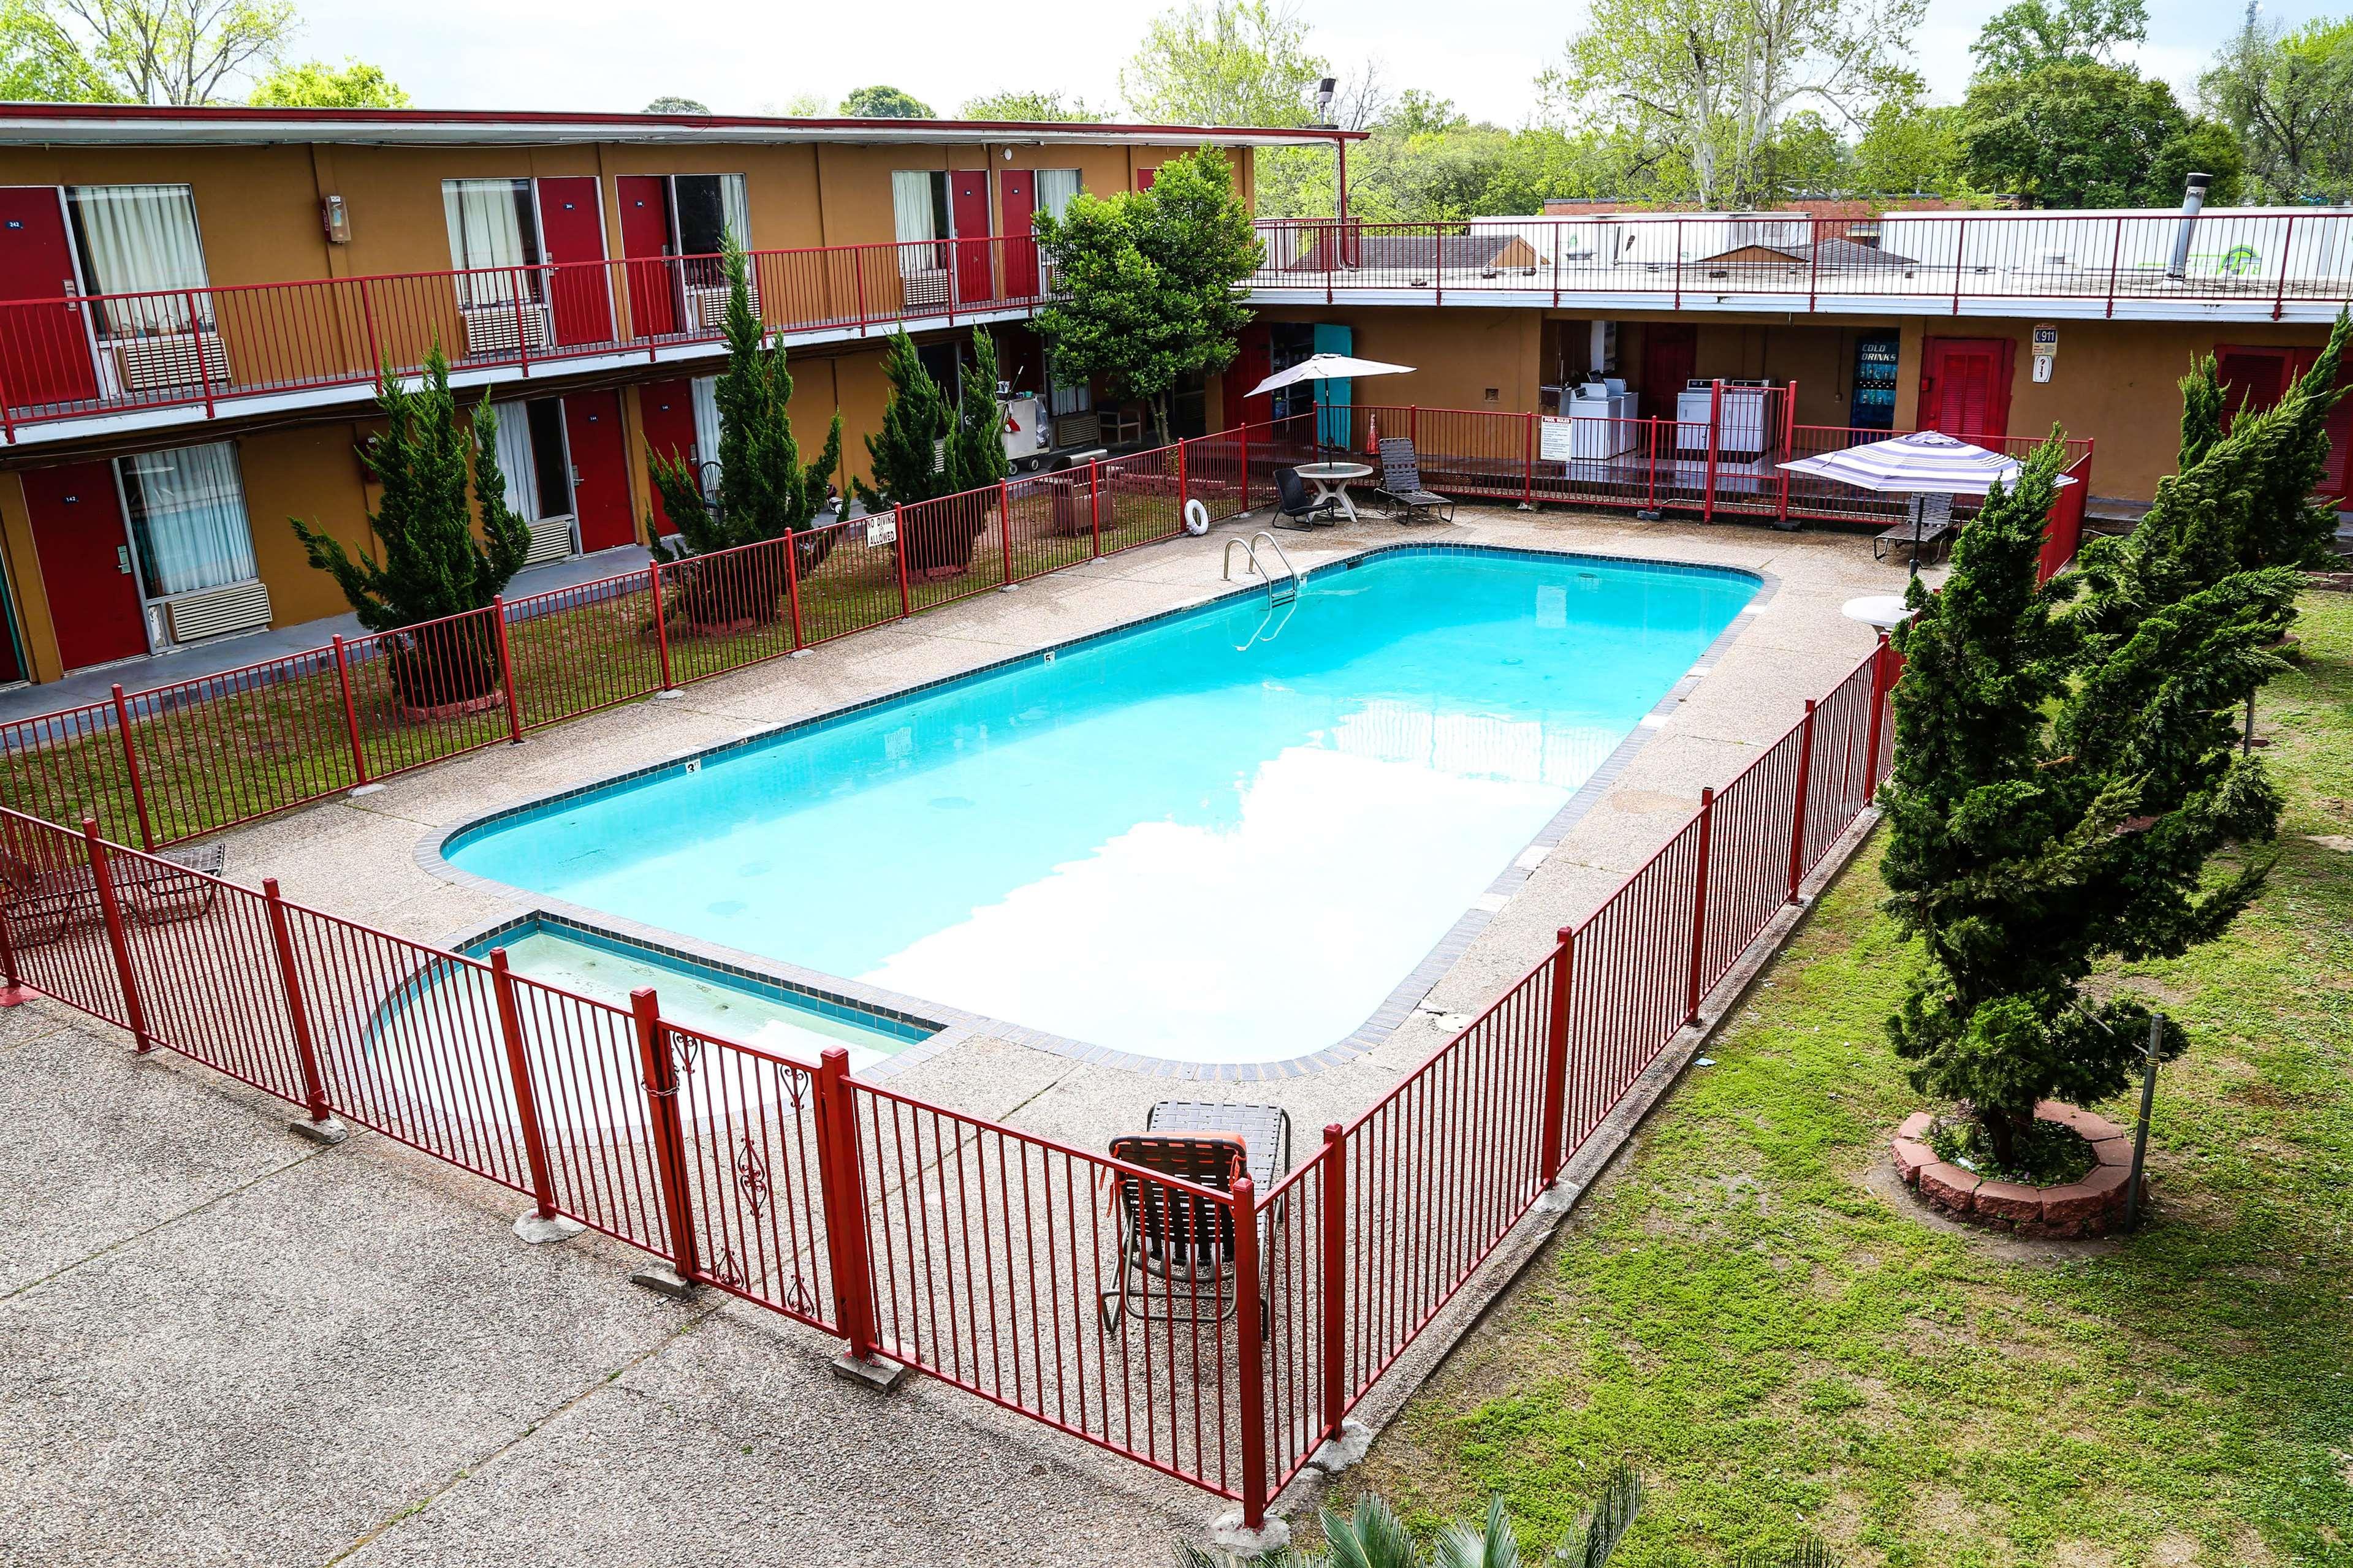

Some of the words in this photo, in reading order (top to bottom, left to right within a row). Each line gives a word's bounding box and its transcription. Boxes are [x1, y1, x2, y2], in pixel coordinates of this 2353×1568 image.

[2041, 331, 2055, 341] 911
[867, 518, 875, 529] NO
[877, 514, 894, 526] DIVING
[870, 531, 894, 544] ALLOWED
[687, 763, 695, 773] 3
